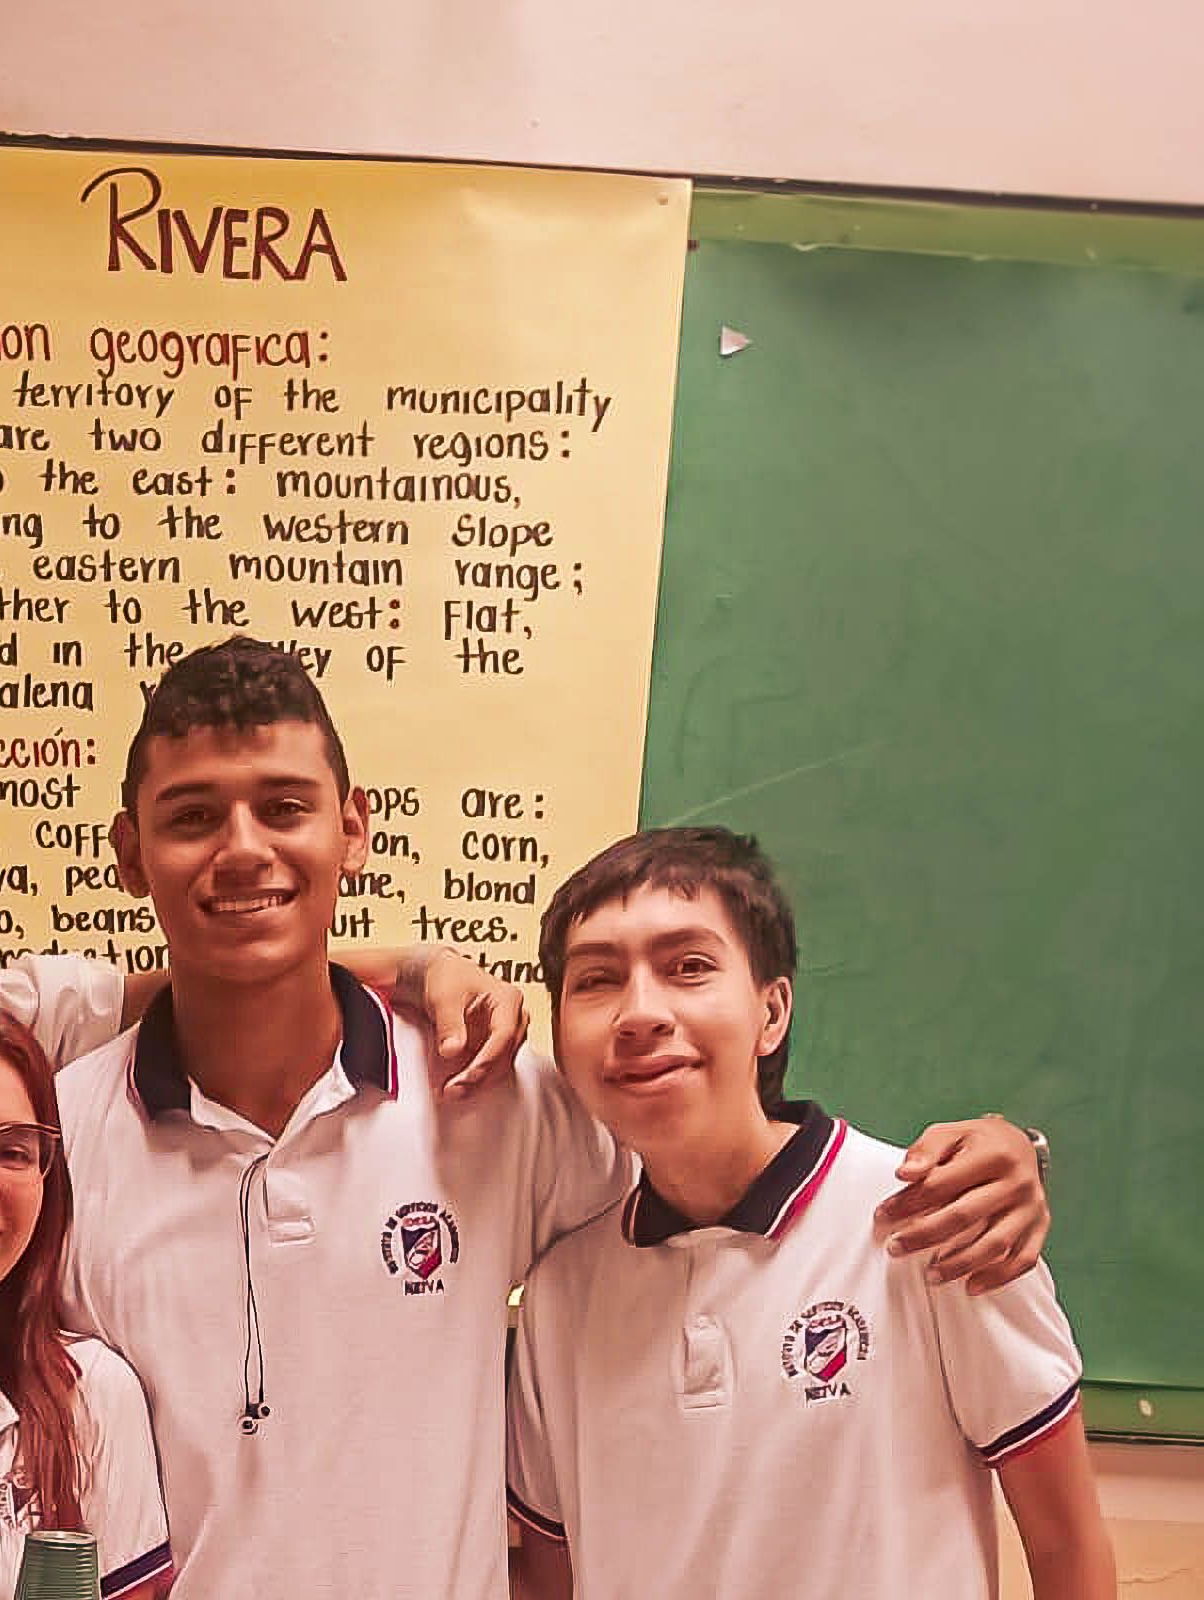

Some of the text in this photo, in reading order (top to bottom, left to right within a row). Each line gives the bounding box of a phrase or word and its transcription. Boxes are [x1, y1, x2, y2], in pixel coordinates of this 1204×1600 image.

[81, 167, 347, 281] RIVERA
[14, 369, 174, 418] territory
[284, 379, 339, 413] the
[387, 378, 612, 432] municipality
[88, 418, 161, 451] two
[414, 430, 570, 466] regions:
[39, 459, 98, 495] the
[277, 467, 521, 509] mountainous,
[82, 503, 120, 539] to
[158, 505, 223, 540] the
[33, 549, 180, 583] eastern
[229, 551, 402, 586] mountain
[104, 589, 142, 624] to
[181, 587, 250, 627] the
[53, 641, 82, 667] in
[124, 633, 184, 668] the
[456, 638, 524, 675] the
[365, 787, 420, 820] ops
[371, 831, 420, 864] on,
[65, 863, 124, 896] pea
[339, 868, 536, 904] ane, blond
[331, 905, 517, 942] uit trees.
